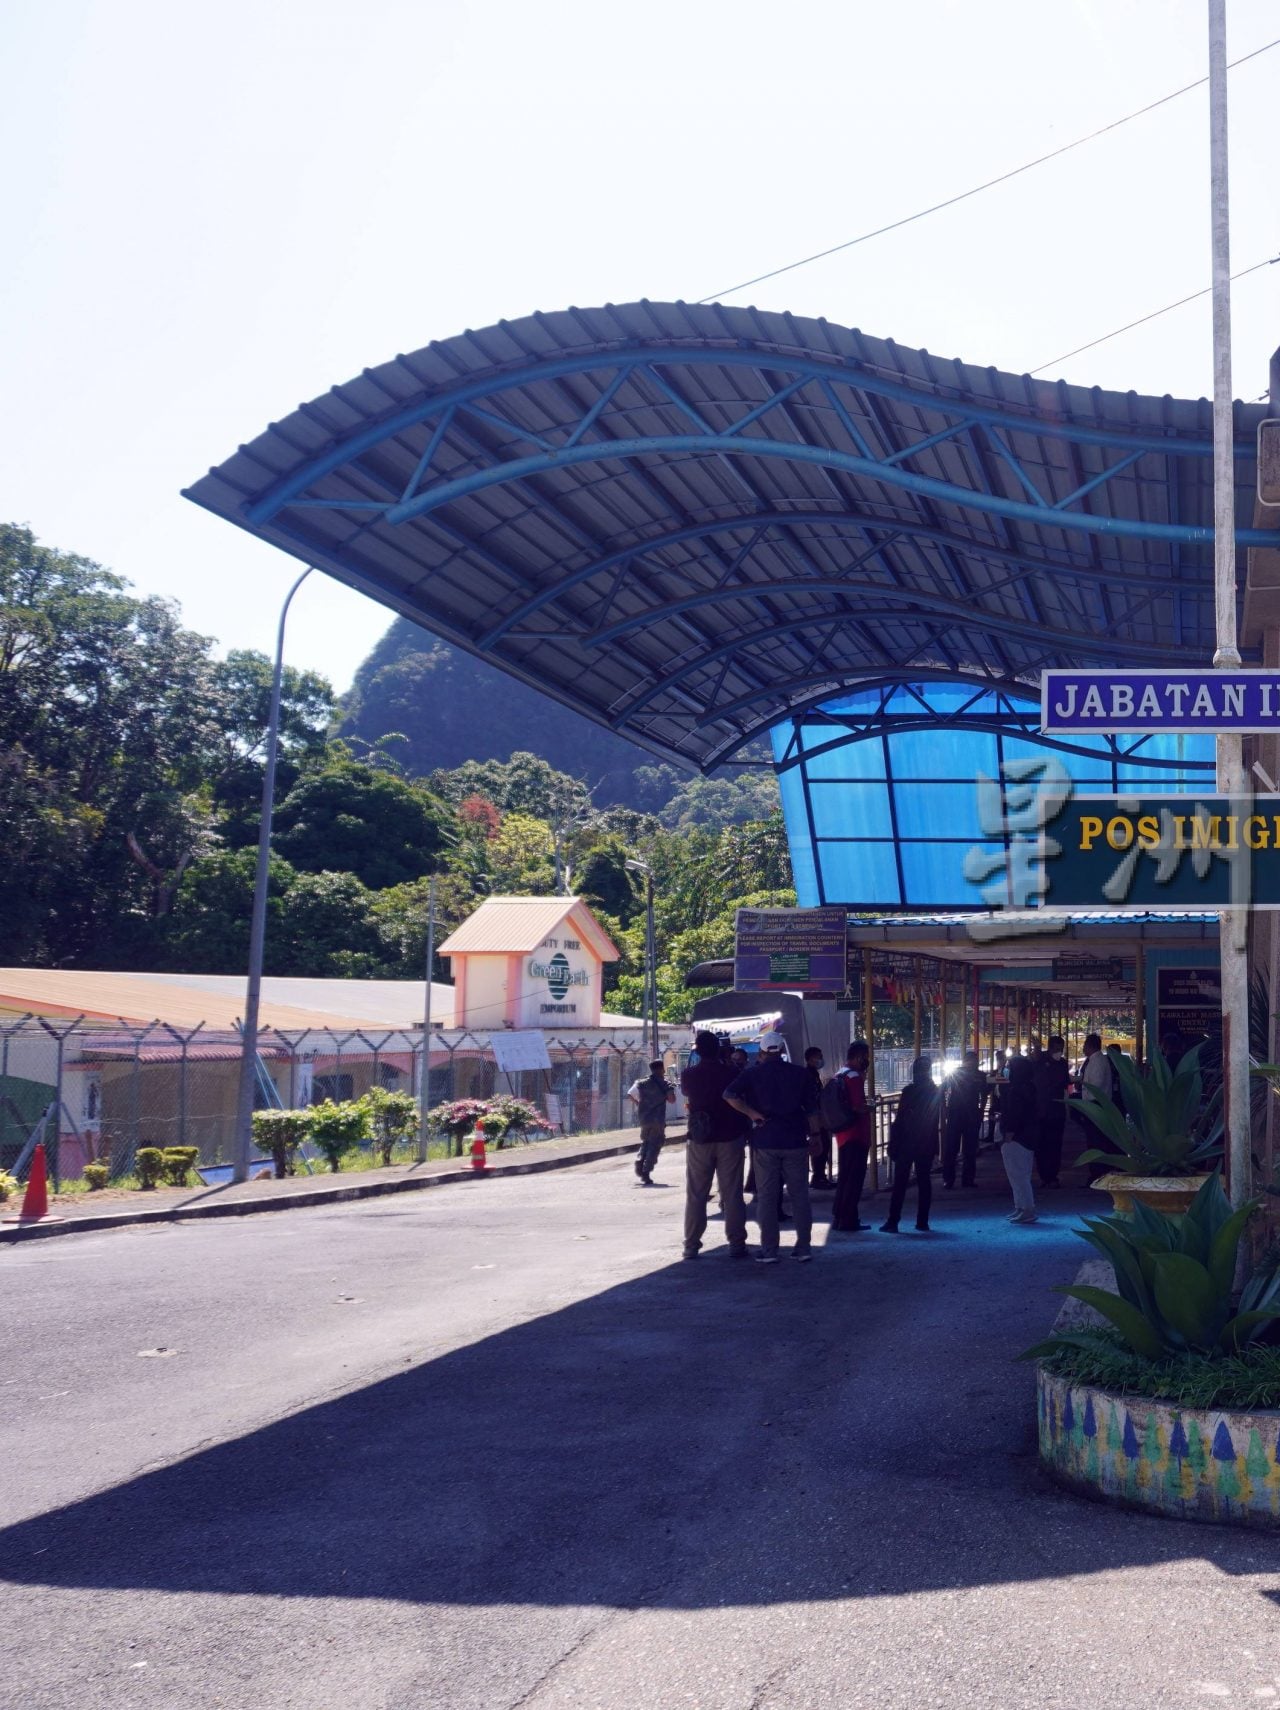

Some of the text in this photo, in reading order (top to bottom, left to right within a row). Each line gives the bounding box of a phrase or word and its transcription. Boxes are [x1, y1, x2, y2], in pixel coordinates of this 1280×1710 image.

[1055, 683, 1247, 718] JABATAN
[1080, 814, 1161, 850] POS
[529, 959, 562, 979] Green
[540, 1003, 577, 1014] EMPORIUM
